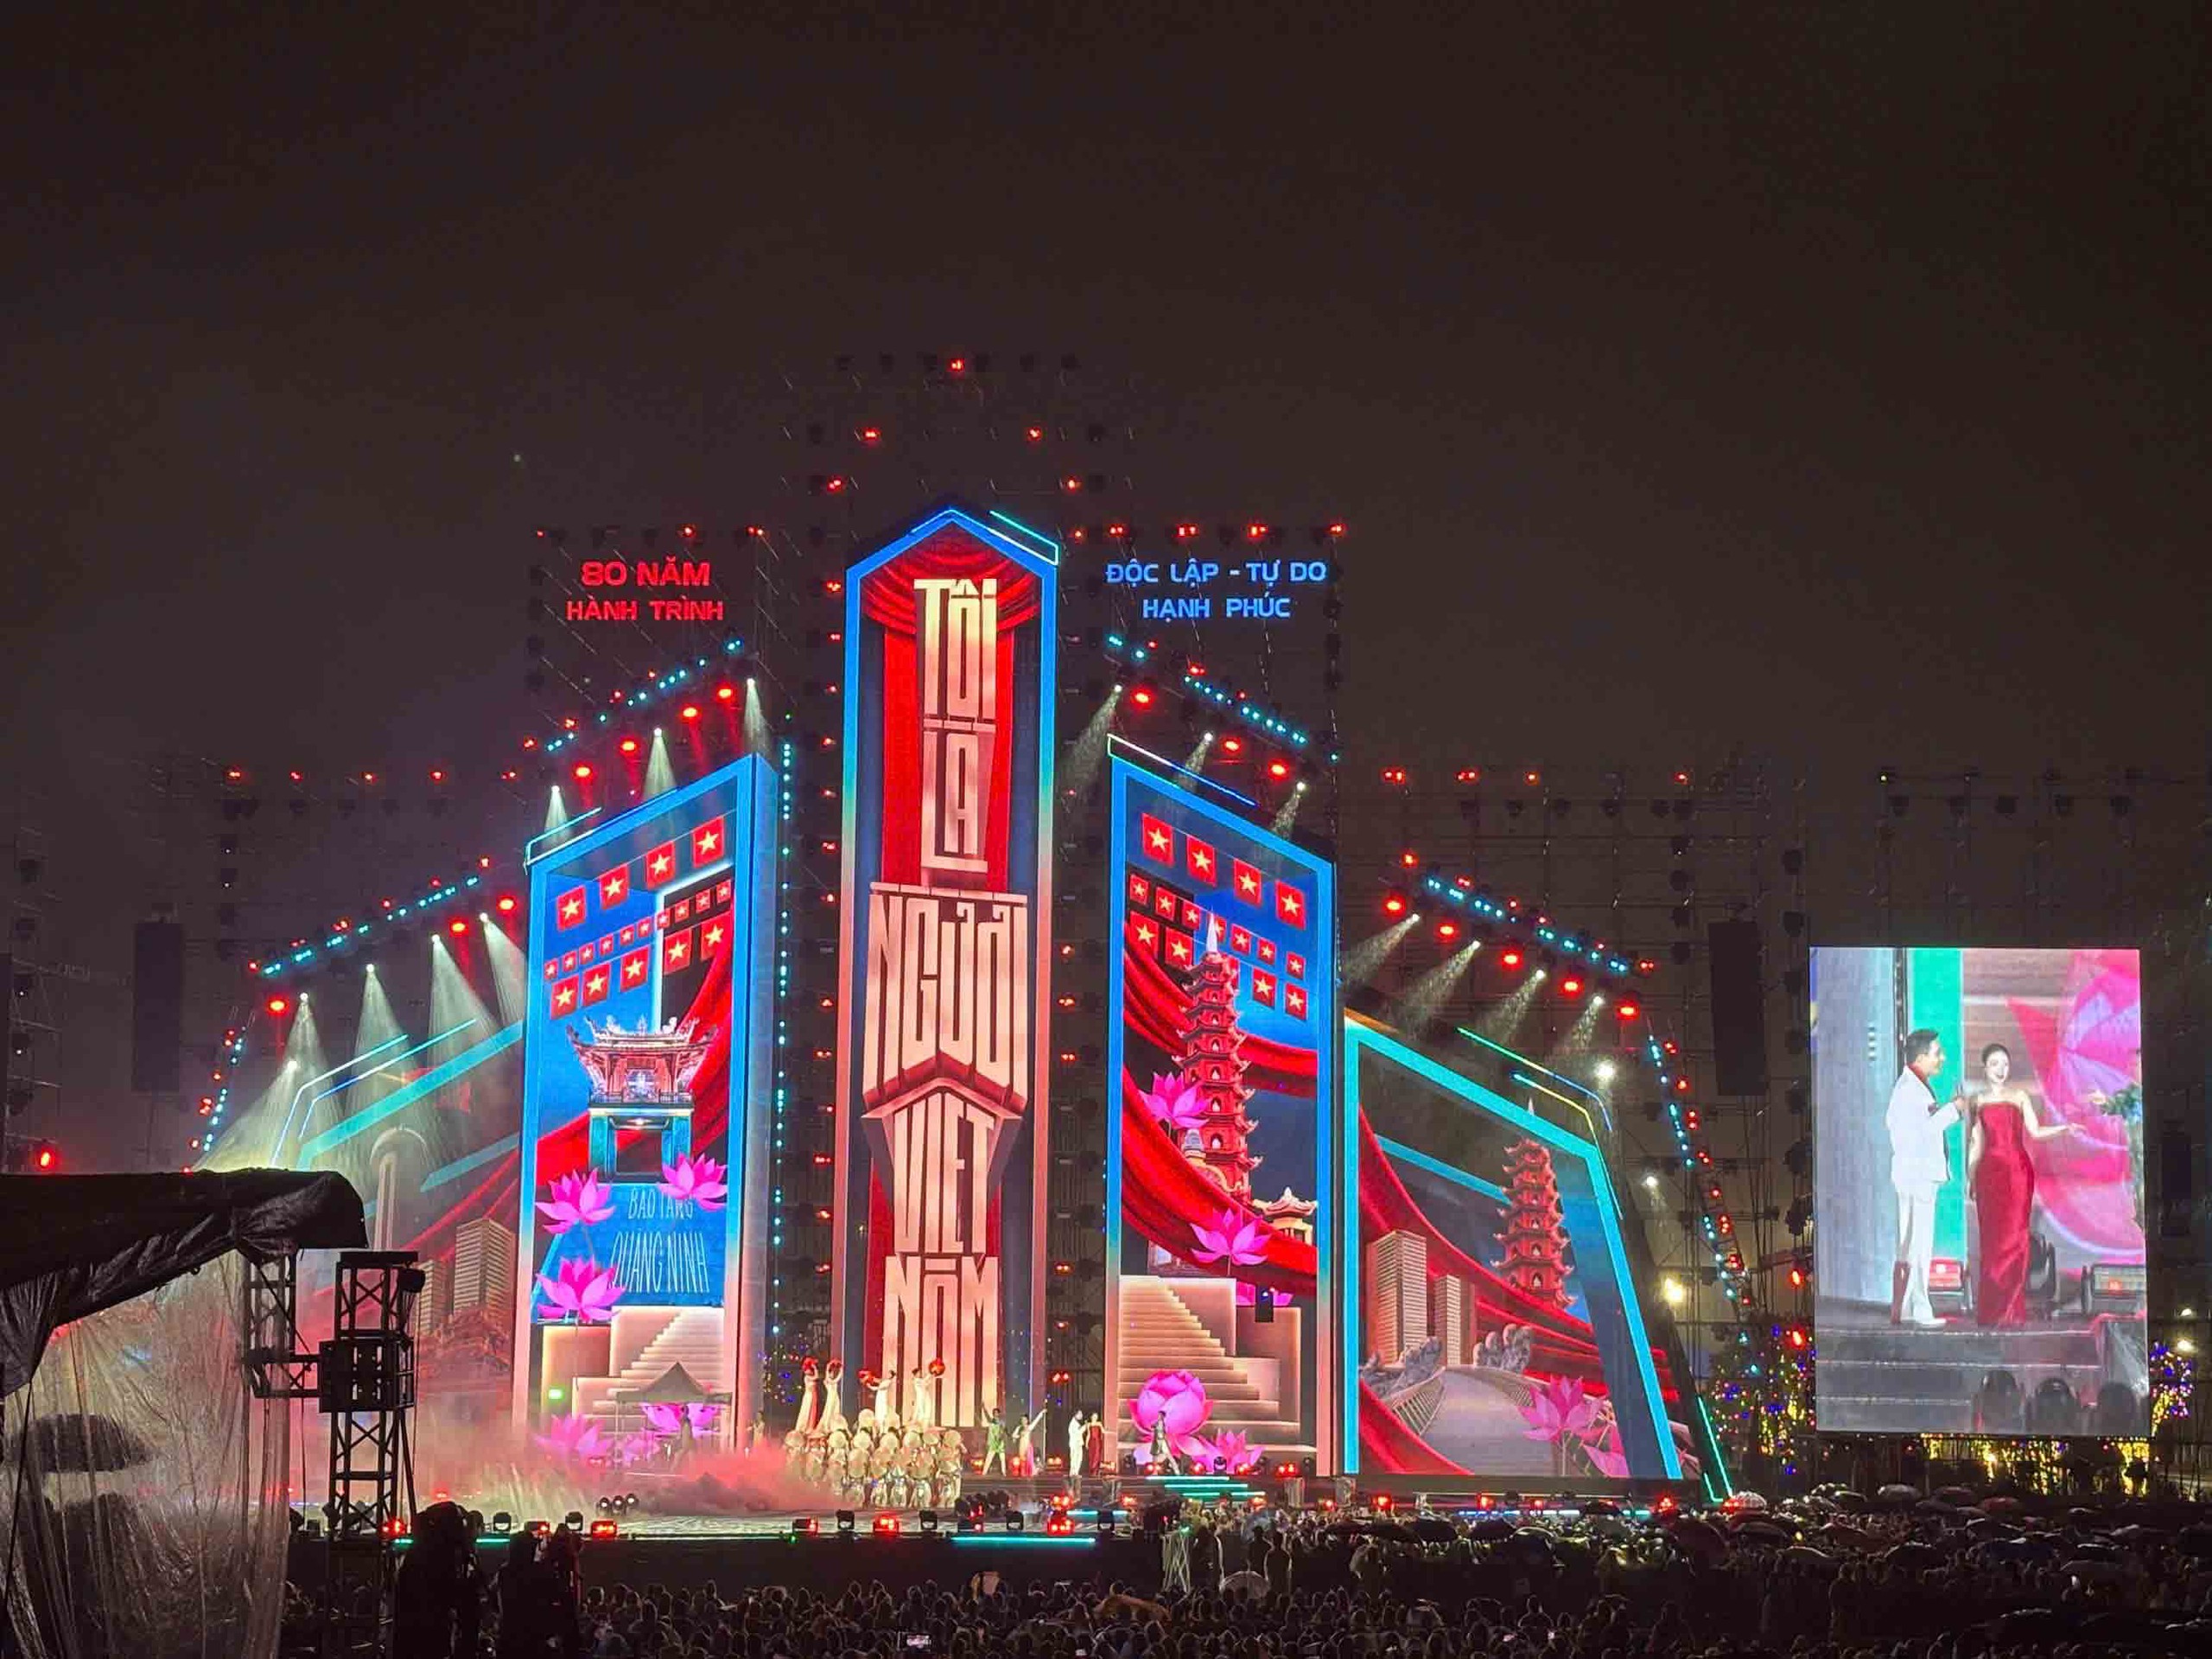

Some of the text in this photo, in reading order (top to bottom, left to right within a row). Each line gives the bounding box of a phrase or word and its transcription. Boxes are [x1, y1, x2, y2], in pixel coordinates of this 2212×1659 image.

[581, 556, 711, 587] 80 NĂM
[1105, 558, 1159, 588] ĐỘC
[1170, 558, 1218, 588] LẬP
[1245, 559, 1281, 588] TỰ
[1290, 562, 1327, 582] DO
[566, 594, 724, 621] HÀNH TRÌNH
[1142, 591, 1291, 623] HẠNH PHÚC
[912, 578, 998, 721] TÔI
[667, 1230, 710, 1294] NINH
[881, 1256, 998, 1427] NAM
